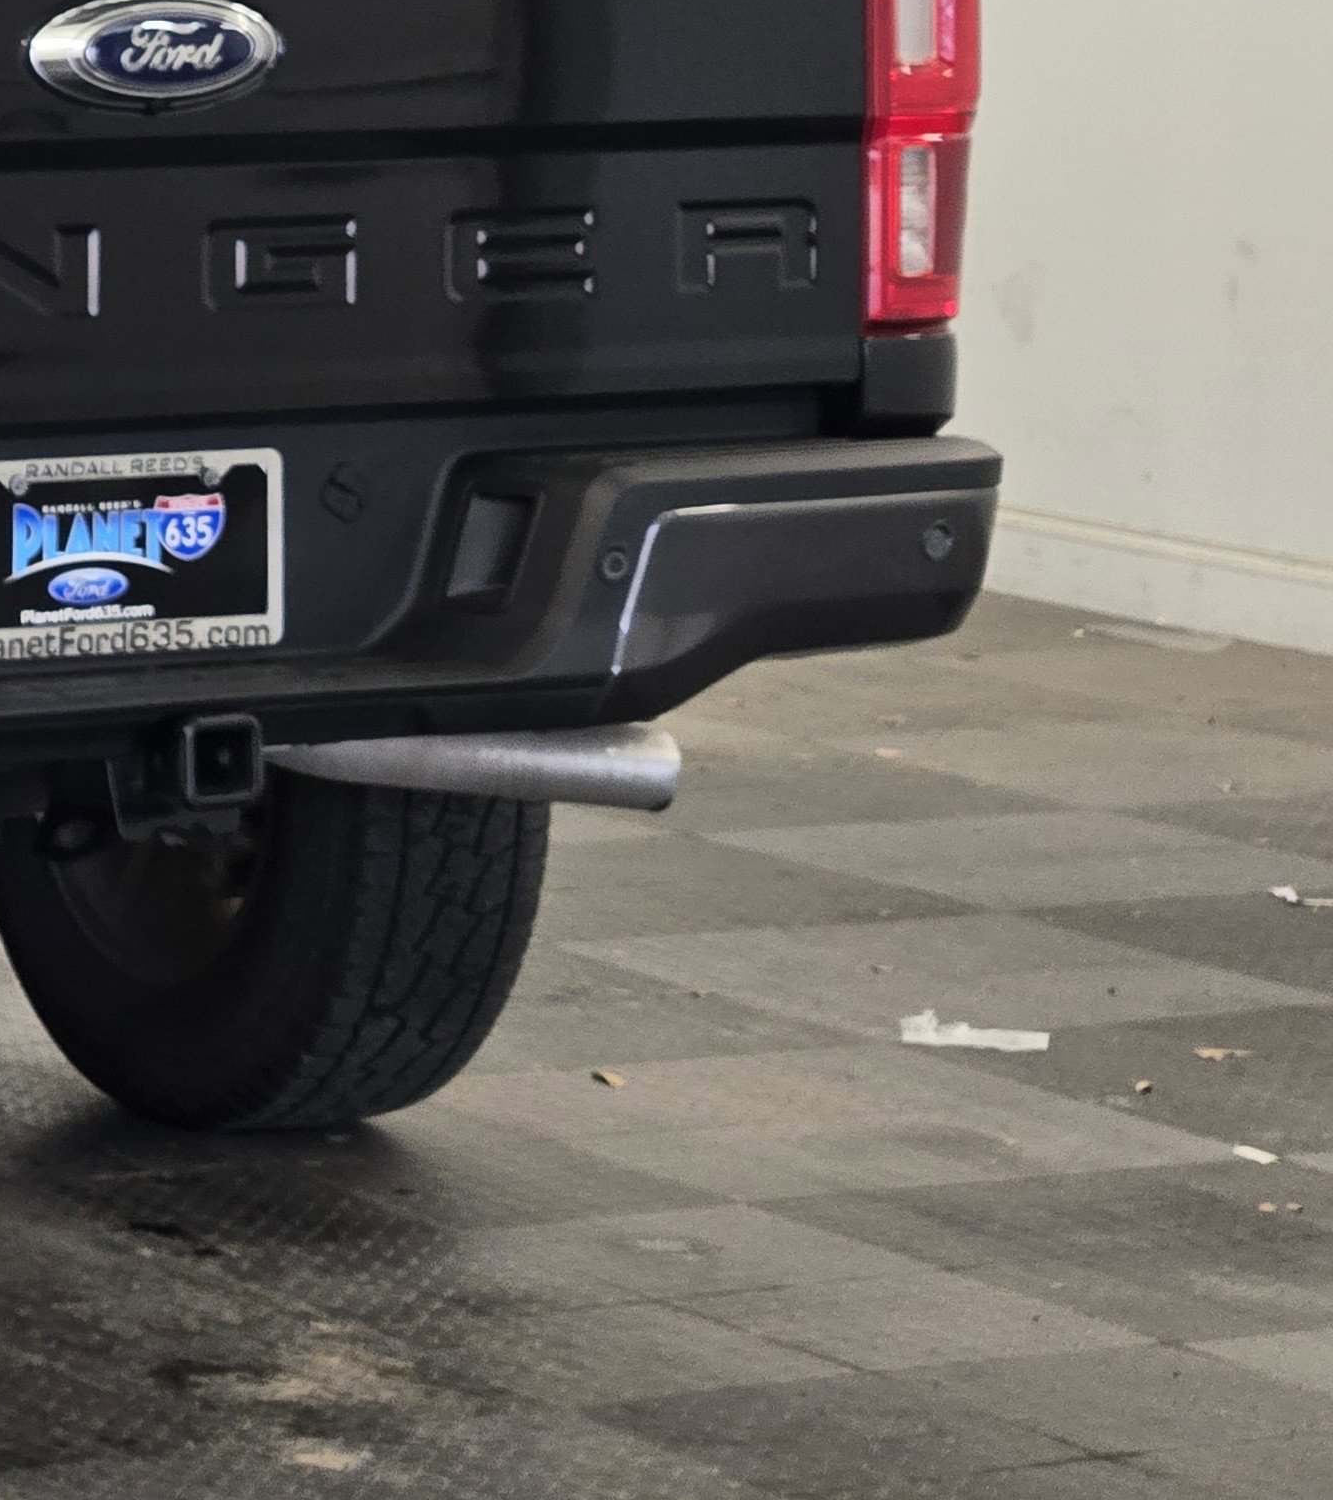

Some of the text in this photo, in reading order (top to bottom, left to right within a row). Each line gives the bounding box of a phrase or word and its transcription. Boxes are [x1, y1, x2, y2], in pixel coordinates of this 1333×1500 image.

[119, 19, 225, 73] Ford
[25, 455, 204, 479] RANDALL REED'S
[12, 503, 214, 577] PLANET 635
[62, 577, 113, 600] Ford
